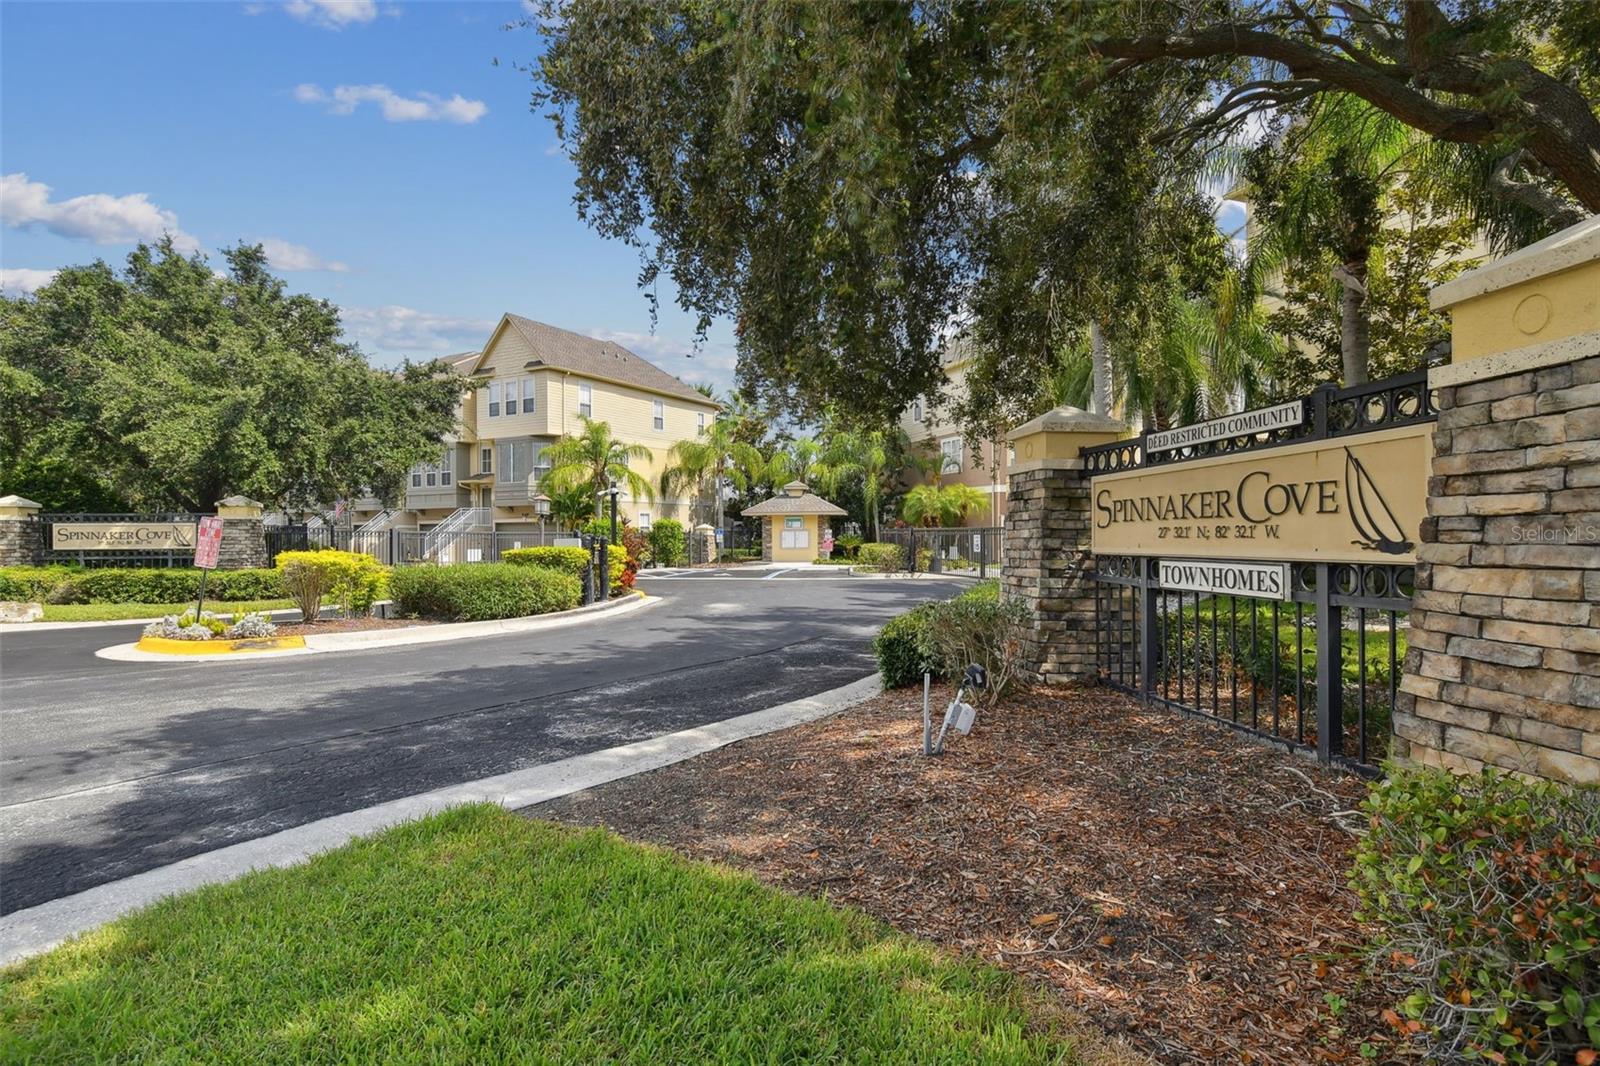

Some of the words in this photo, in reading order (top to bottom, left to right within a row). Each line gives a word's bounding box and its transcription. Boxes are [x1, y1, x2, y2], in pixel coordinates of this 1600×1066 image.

[1148, 434, 1169, 450] DEED
[1170, 422, 1226, 445] RESTRICTED
[1228, 405, 1300, 433] COMMUNITY
[1096, 489, 1234, 529] SPINNAKER
[1237, 471, 1340, 524] COVE
[57, 528, 135, 542] SPINNAKER
[135, 528, 172, 541] COVE
[1162, 564, 1281, 594] TOWNHOMES
